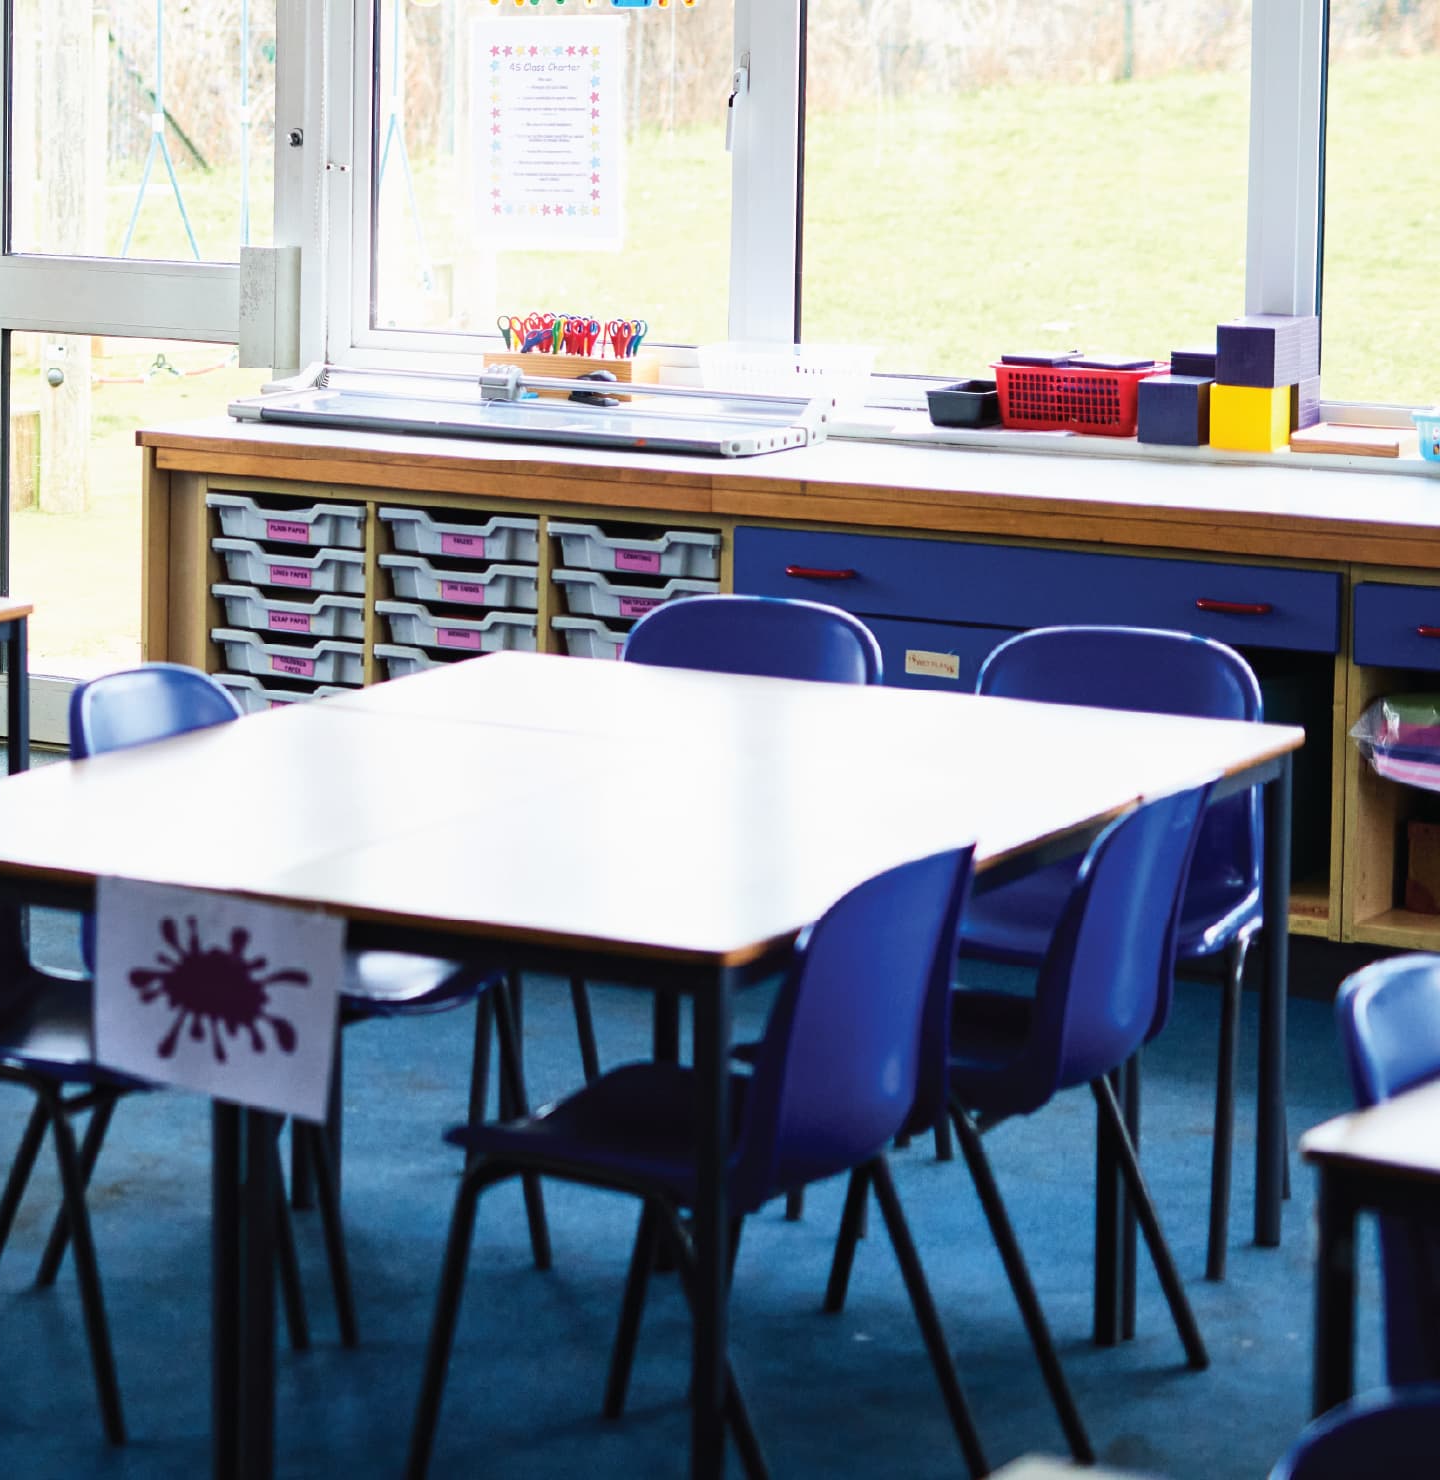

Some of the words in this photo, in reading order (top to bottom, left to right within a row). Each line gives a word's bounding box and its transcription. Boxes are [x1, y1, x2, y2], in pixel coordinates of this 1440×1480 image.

[523, 62, 545, 72] Class
[547, 62, 581, 72] Charter
[288, 526, 306, 534] PAPER
[290, 571, 307, 579] PAPER
[271, 615, 288, 623] SCRAP
[290, 617, 307, 625] PAPER
